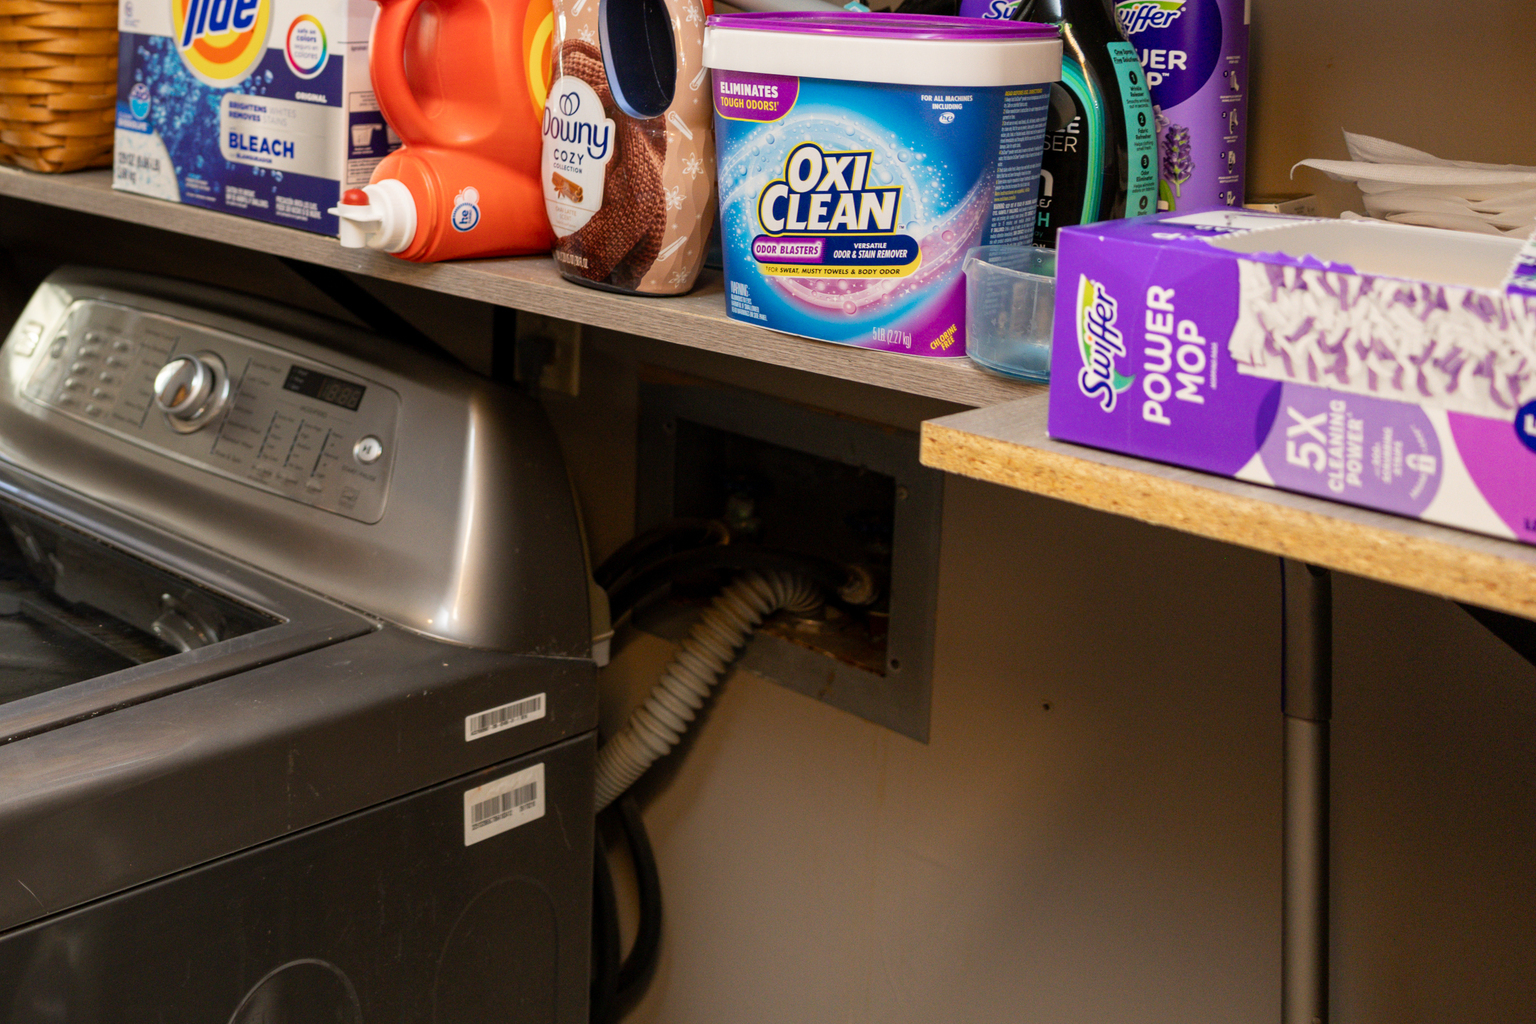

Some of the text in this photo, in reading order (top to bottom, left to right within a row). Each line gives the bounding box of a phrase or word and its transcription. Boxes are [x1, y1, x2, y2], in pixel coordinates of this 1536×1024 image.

[295, 91, 328, 104] ORIGINAL
[720, 80, 779, 98] ELIMINATES
[228, 101, 267, 114] BRIGHTENS
[720, 96, 744, 109] TOUGH
[228, 110, 261, 122] REMOVES
[543, 105, 610, 160] Downy
[228, 132, 295, 160] BLEACH
[554, 148, 585, 166] COZY
[553, 162, 583, 174] COLLECTION
[787, 146, 868, 192] OXI
[760, 184, 898, 233] CLEAN
[756, 244, 777, 254] ODOR
[833, 250, 908, 259] ODOR & STAIN REMOVER
[872, 326, 877, 340] 5
[887, 329, 902, 345] (2.27
[902, 332, 912, 349] kg)
[930, 323, 958, 350] CHLORINE
[941, 336, 955, 351] FREE
[1081, 282, 1126, 411] Swiffer
[1142, 285, 1176, 426] POWER
[1176, 319, 1207, 404] MOP
[1285, 405, 1330, 474] 5X
[1327, 398, 1347, 494] CLEANING
